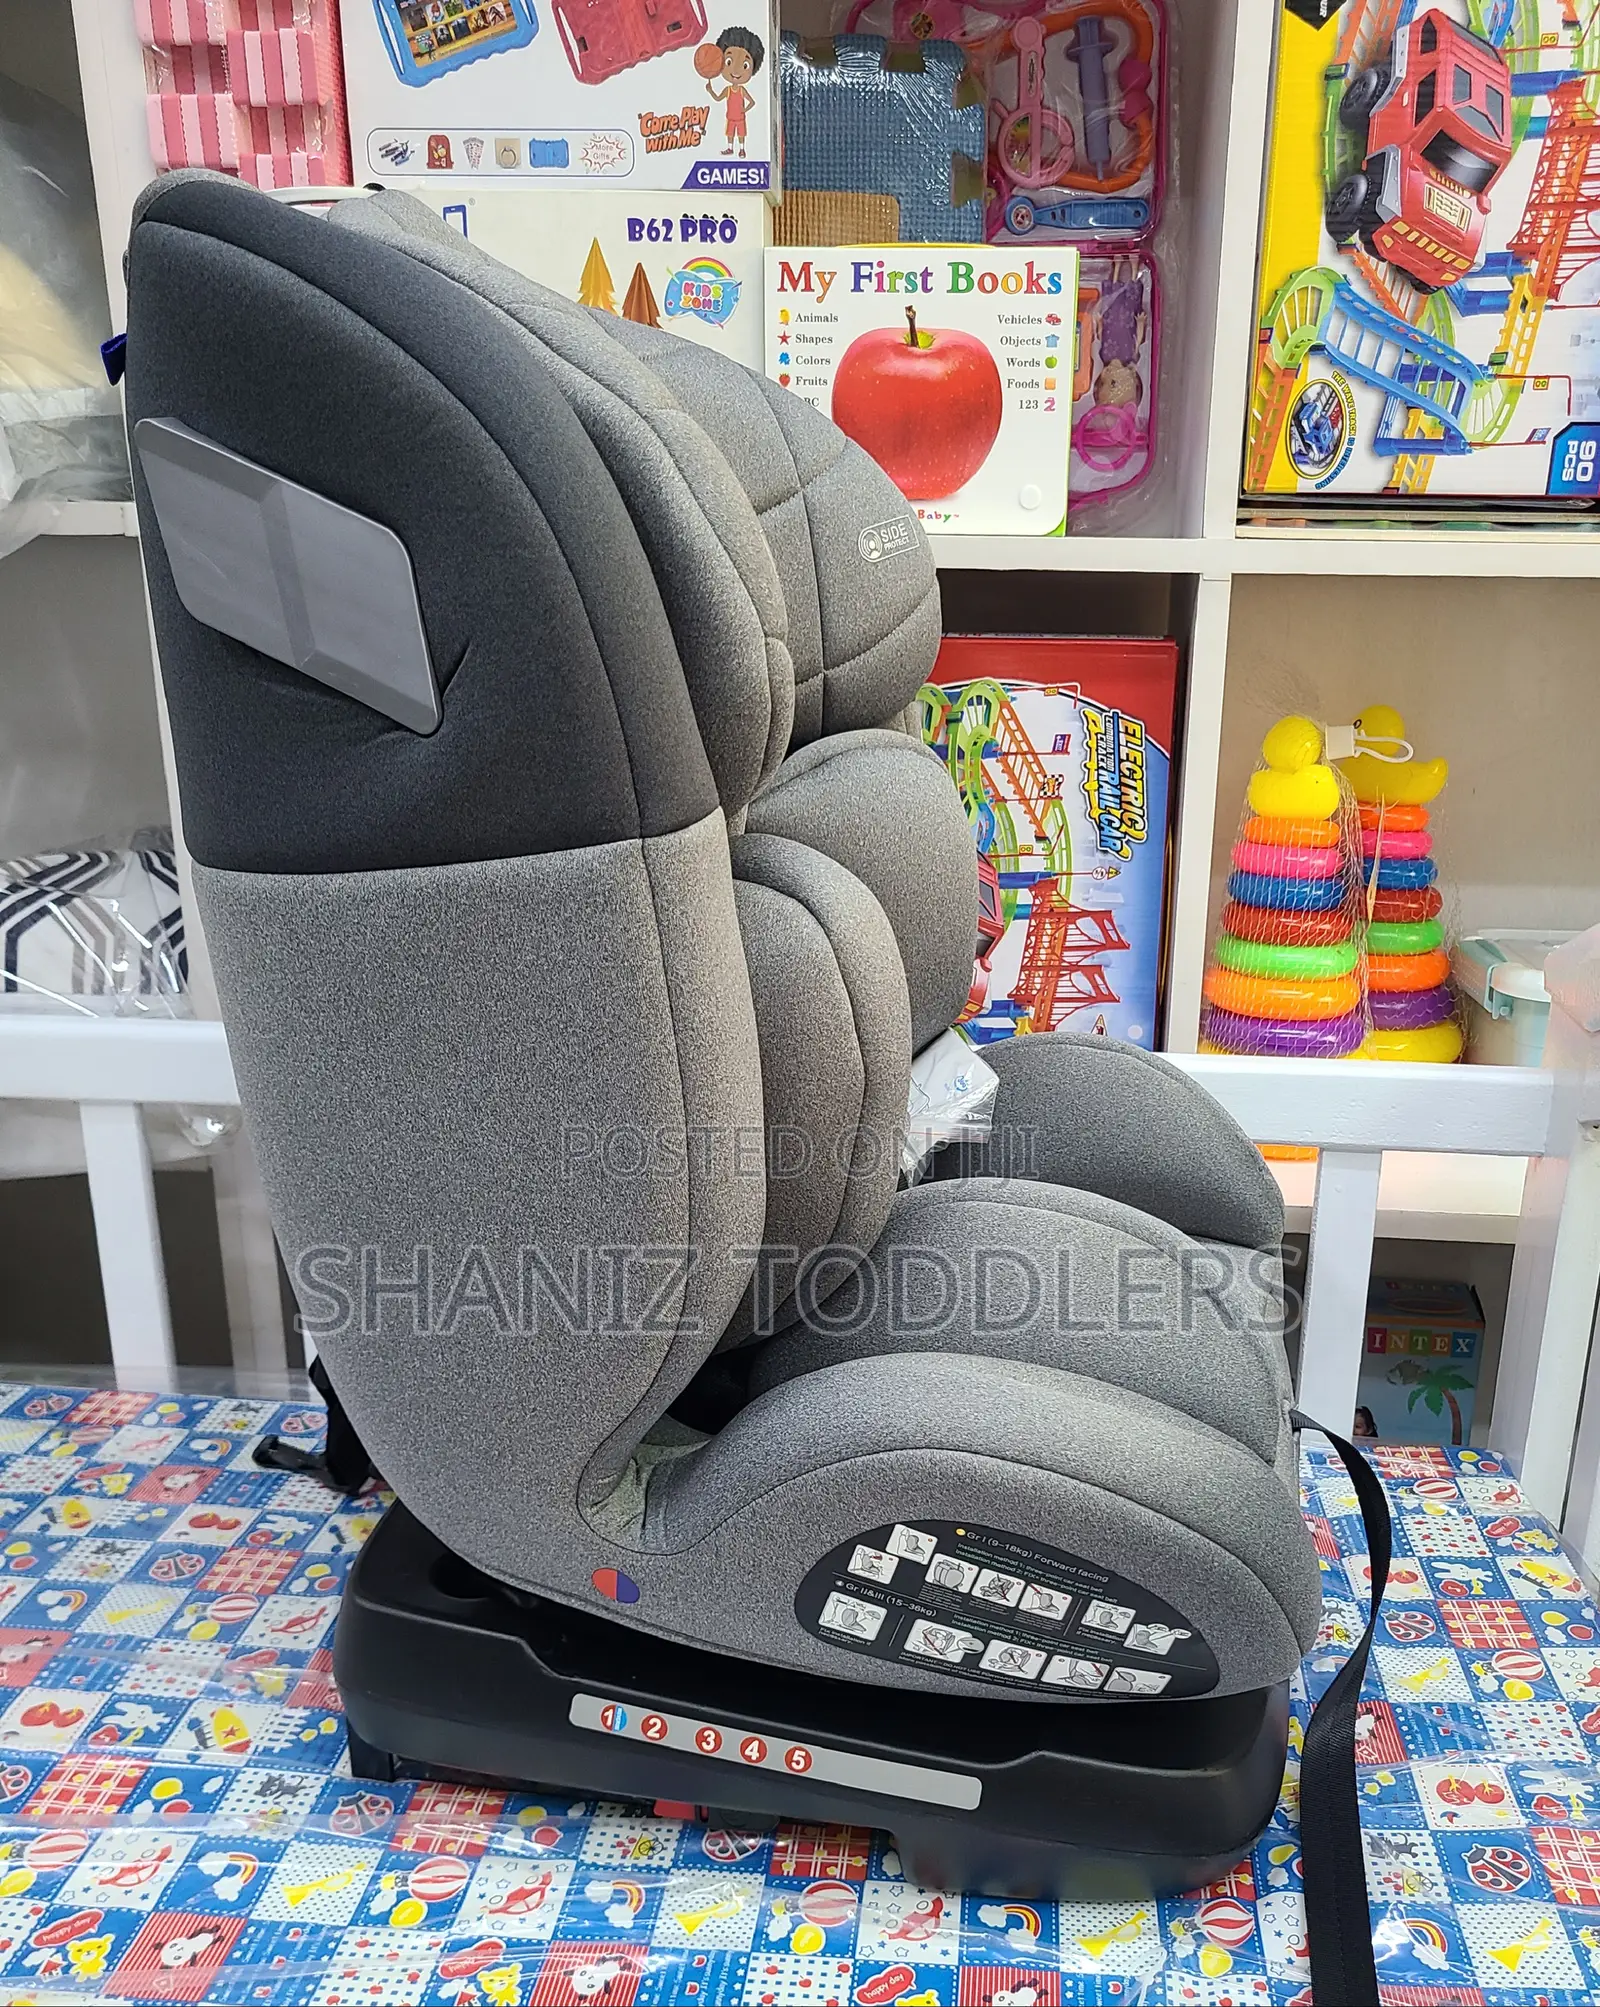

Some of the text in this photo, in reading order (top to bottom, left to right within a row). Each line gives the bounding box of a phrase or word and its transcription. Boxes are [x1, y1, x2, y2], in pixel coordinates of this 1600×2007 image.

[680, 106, 710, 130] Play
[595, 144, 614, 152] More
[646, 132, 679, 154] with
[593, 152, 611, 161] Gifts
[697, 167, 765, 185] GAMES!
[627, 213, 739, 244] B62 PRO
[683, 281, 723, 299] KIDS
[777, 261, 1062, 304] My First Books
[681, 295, 721, 312] ZONE
[795, 312, 839, 324] Animals
[997, 313, 1042, 326] Vehicles
[795, 334, 833, 346] Shapes
[1000, 335, 1042, 348] Objects
[795, 355, 831, 367] Colors
[1006, 357, 1041, 368] Words
[795, 375, 828, 387] Fruits
[1006, 379, 1040, 390] Foods
[1331, 370, 1347, 387] THE
[803, 396, 820, 408] BC
[1341, 383, 1356, 408] WAVE
[1018, 400, 1039, 411] 123
[1348, 407, 1358, 437] TRACK
[1315, 446, 1353, 491] INTERESTING
[1561, 440, 1579, 482] PCS
[1576, 440, 1597, 482] 90
[880, 522, 908, 543] SIDE
[883, 536, 910, 551] PROTECT
[1119, 716, 1145, 832] ELECTRIC
[1098, 770, 1126, 852] RAIL CAR
[1373, 1332, 1474, 1353] INTEX
[955, 1549, 991, 1565] Installation
[991, 1561, 1016, 1572] method
[957, 1543, 993, 1558] Installation
[993, 1555, 1019, 1567] method
[966, 1531, 981, 1541] Gr
[1033, 1553, 1077, 1573] Forward
[1077, 1568, 1109, 1583] facing
[845, 1582, 859, 1592] Gr
[951, 1619, 987, 1633] Installation
[953, 1613, 989, 1628] Installation
[989, 1624, 1014, 1634] method
[603, 1708, 614, 1727] 1
[647, 1717, 662, 1739] 2
[701, 1730, 716, 1751] 3
[744, 1739, 760, 1760] 4
[790, 1749, 806, 1770] 5
[863, 1973, 905, 1999] happy day
